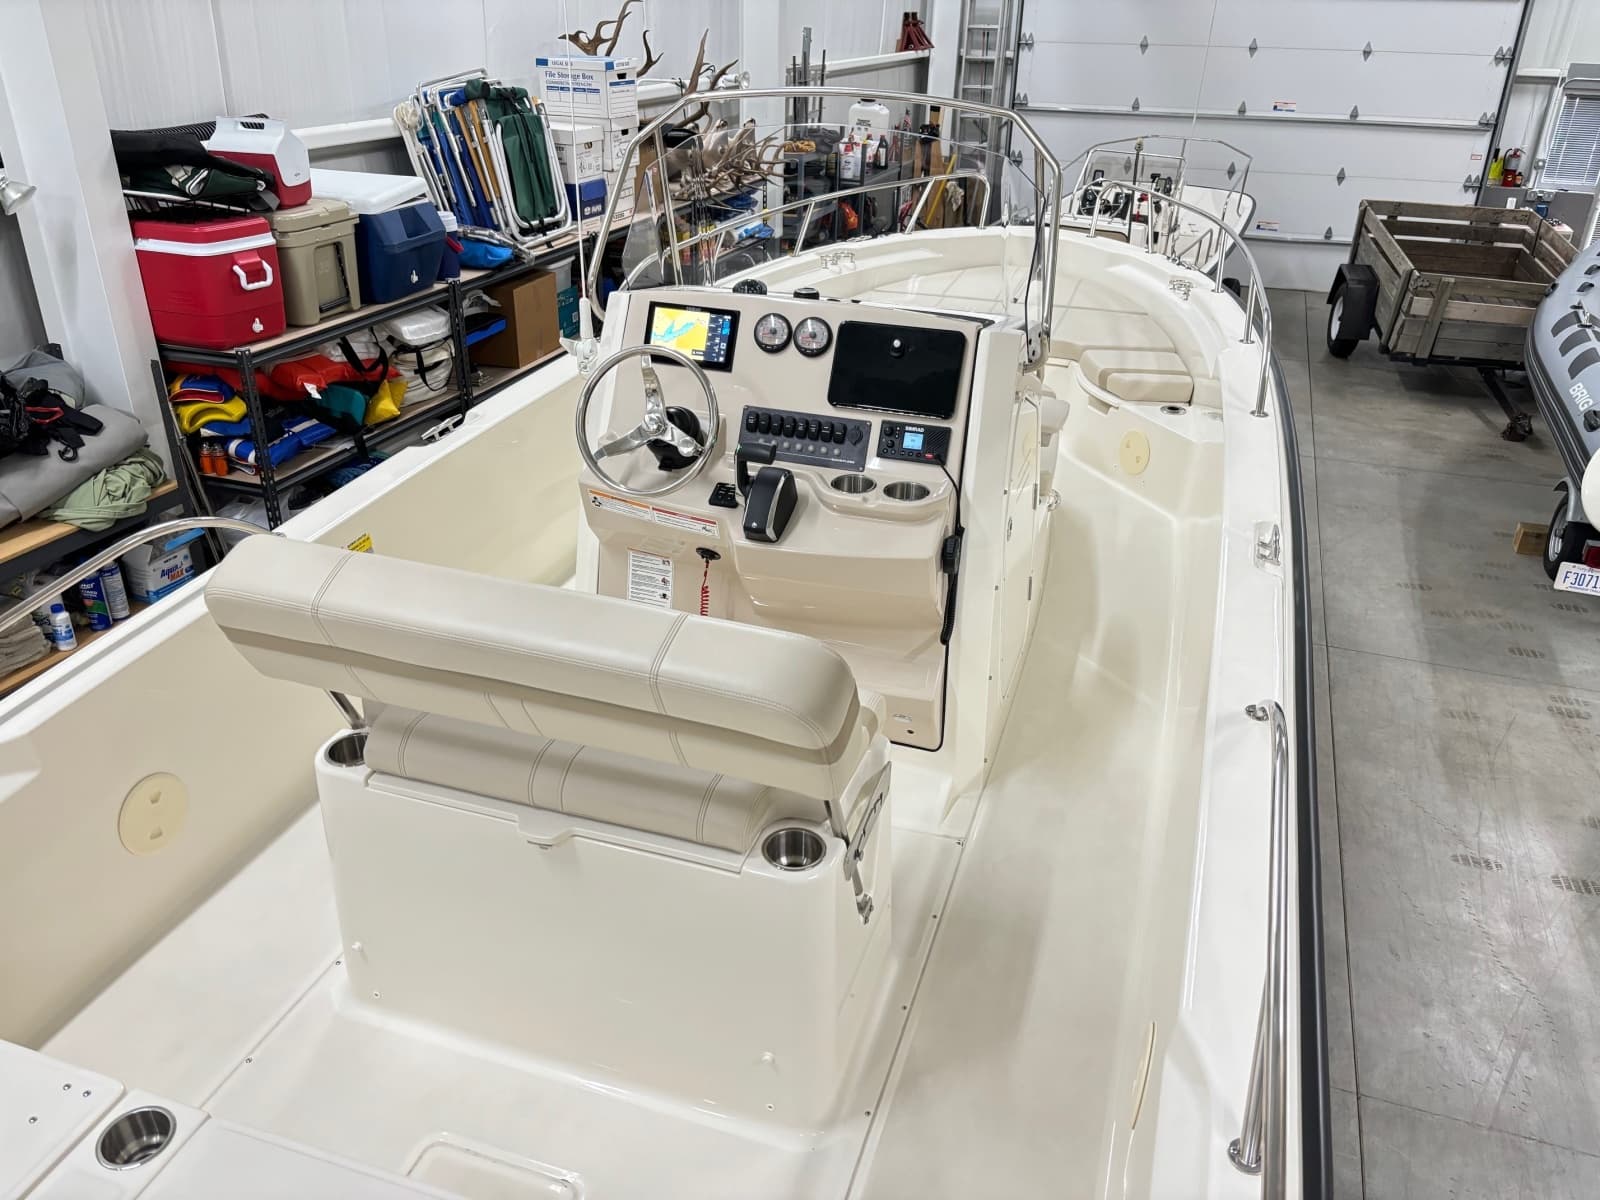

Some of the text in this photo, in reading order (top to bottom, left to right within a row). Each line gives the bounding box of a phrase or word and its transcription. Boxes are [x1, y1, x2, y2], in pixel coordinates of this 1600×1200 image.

[545, 70, 556, 78] File
[581, 72, 594, 81] Box
[1569, 382, 1593, 412] BRIG
[1563, 570, 1600, 589] F3071
